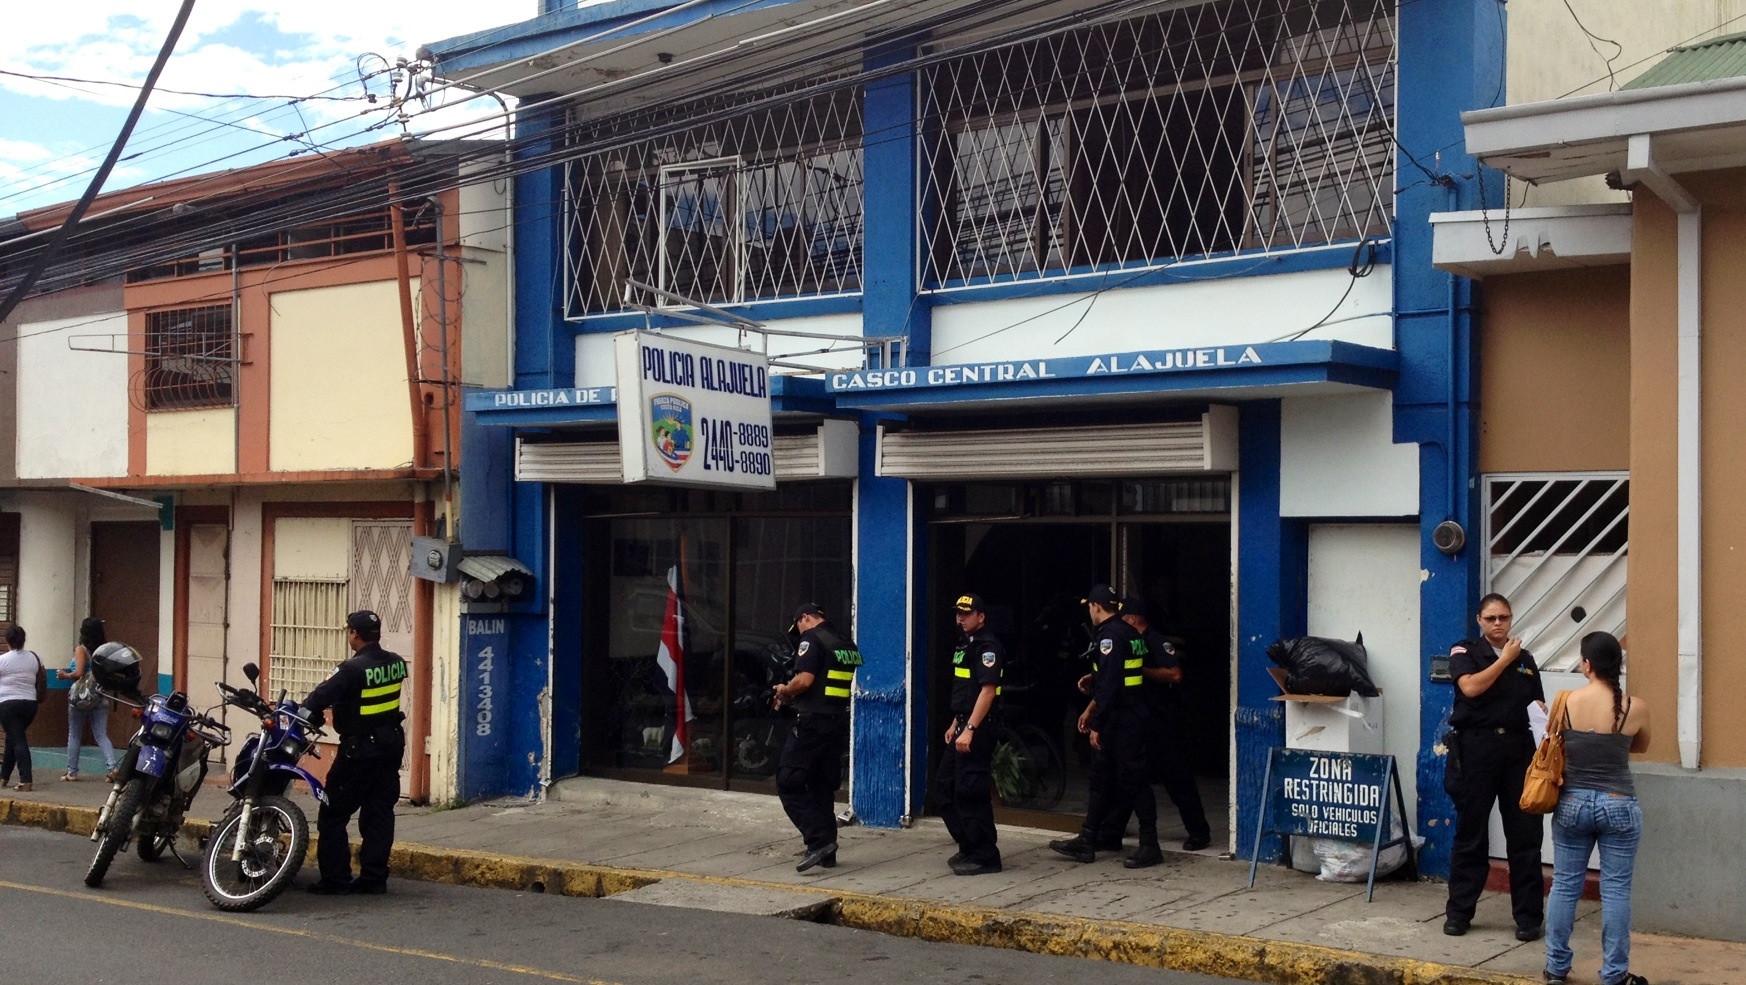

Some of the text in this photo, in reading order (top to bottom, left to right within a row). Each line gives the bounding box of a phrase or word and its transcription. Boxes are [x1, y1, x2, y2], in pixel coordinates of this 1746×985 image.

[642, 346, 767, 399] POLICIA ALAJUELA
[832, 346, 1262, 389] CASCO CENTRAL ALAJUELA
[495, 391, 569, 407] POLICIA
[576, 389, 600, 403] DE
[468, 619, 504, 635] BALIN
[365, 661, 406, 686] POLICIA
[1309, 757, 1352, 781] ZONA
[1284, 778, 1379, 807] RESTRINGIDA
[1292, 803, 1377, 824] SOLO VEHICULOS
